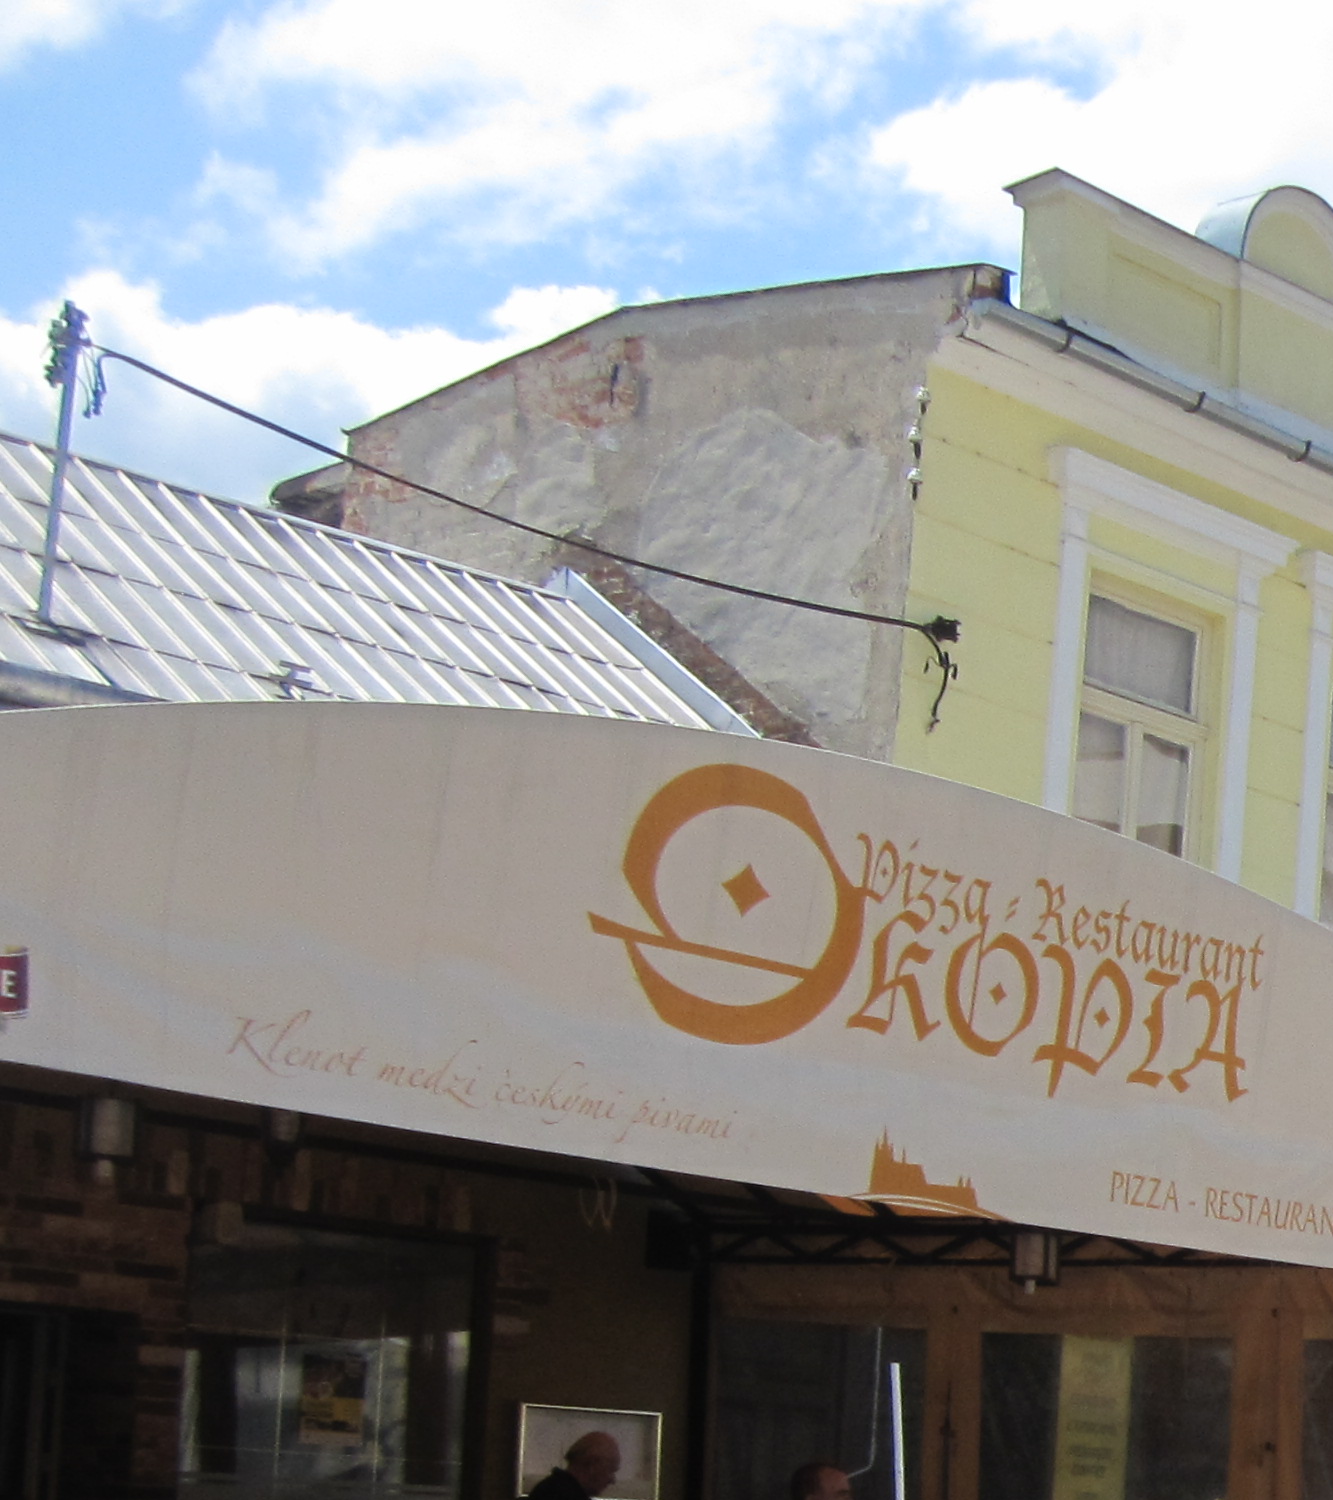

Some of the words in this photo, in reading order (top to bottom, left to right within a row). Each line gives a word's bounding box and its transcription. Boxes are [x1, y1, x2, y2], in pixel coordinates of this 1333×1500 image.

[857, 832, 994, 935] Pizza
[1032, 878, 1265, 991] Restaurant
[227, 1010, 362, 1078] Klenot
[379, 1040, 480, 1108] medzi
[1110, 1170, 1180, 1213] PIZZA
